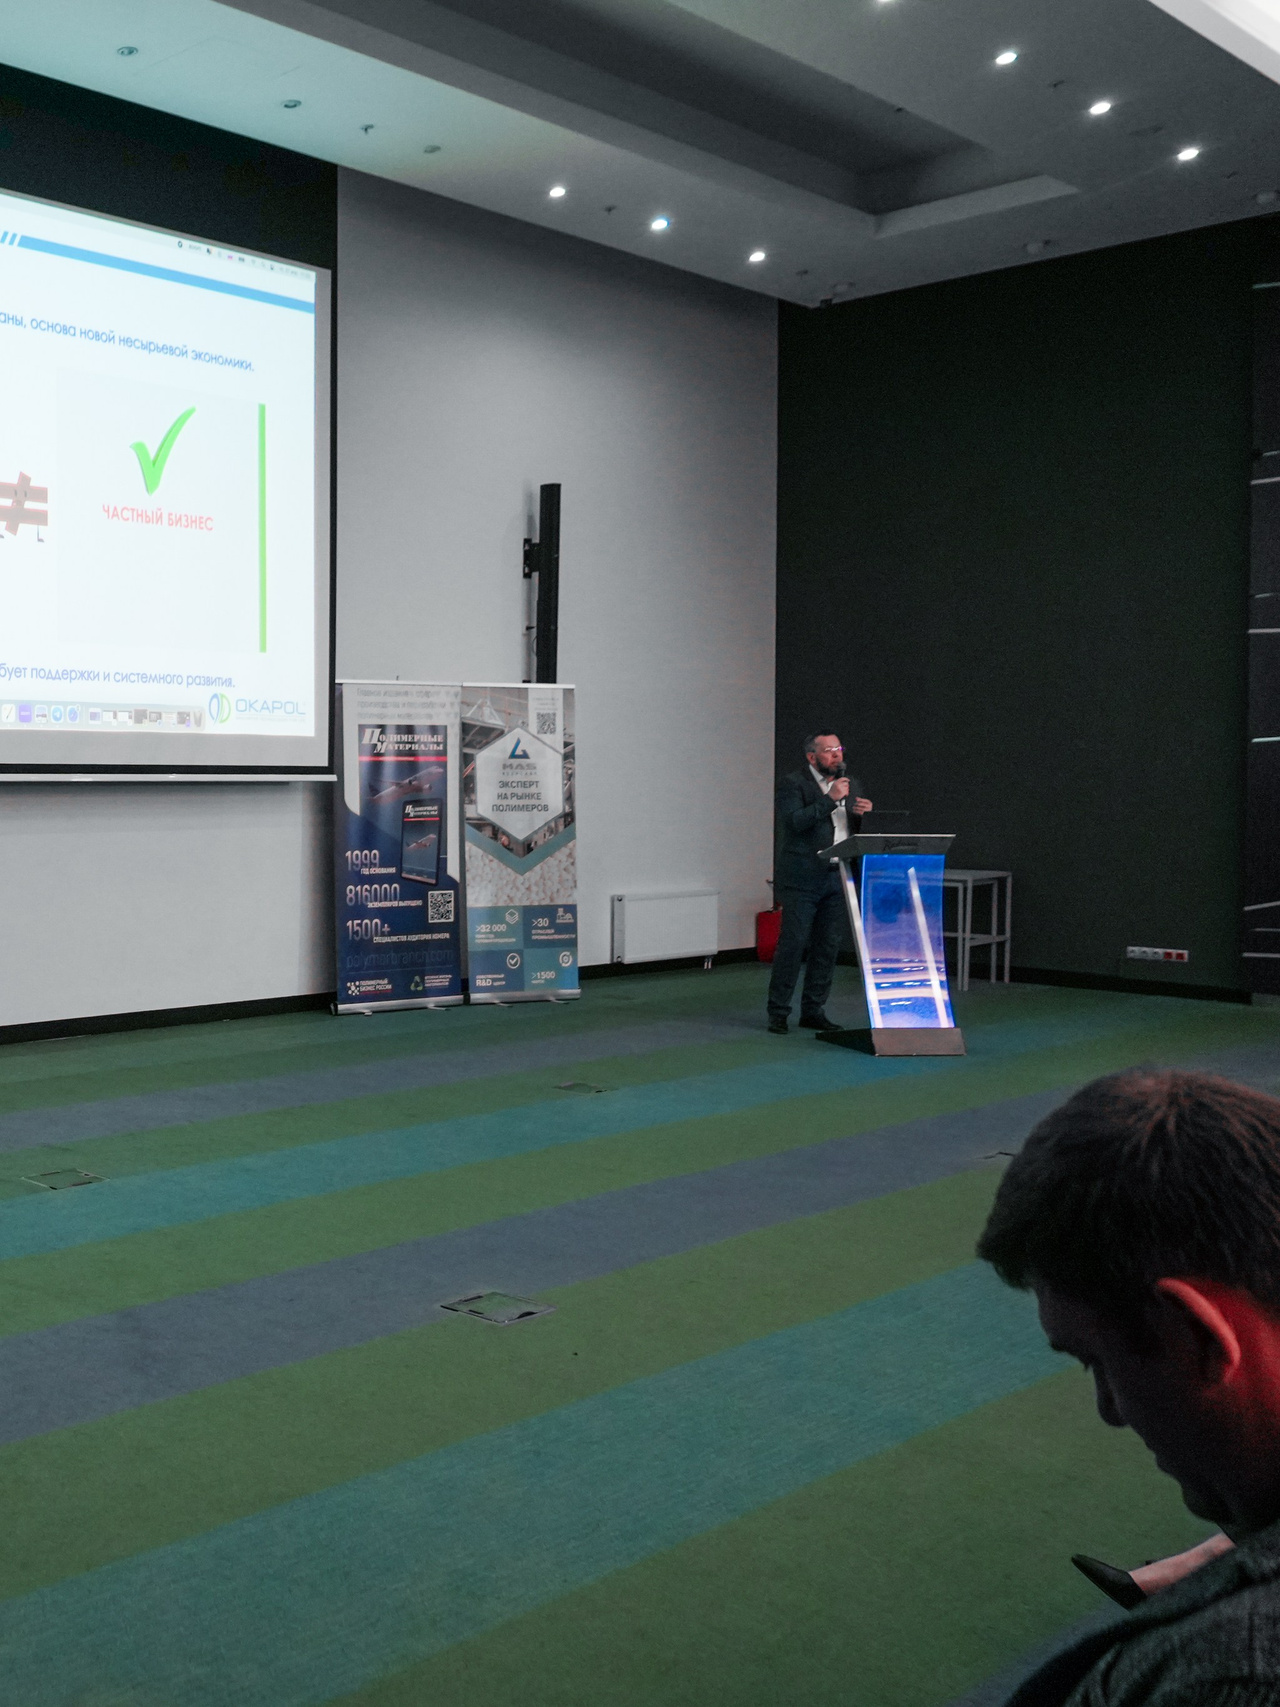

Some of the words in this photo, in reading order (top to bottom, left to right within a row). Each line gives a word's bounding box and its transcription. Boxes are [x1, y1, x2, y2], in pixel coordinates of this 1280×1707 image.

[30, 318, 76, 337] основа
[80, 328, 115, 344] новой
[119, 336, 188, 358] несырьевой
[191, 350, 254, 371] экономики.
[102, 504, 163, 526] ЧАСТНЫЙ
[168, 512, 214, 531] БИЗНЕС
[30, 667, 101, 683] поддержки
[103, 671, 111, 682] и
[113, 671, 183, 686] системного
[186, 675, 235, 688] развития.
[236, 699, 306, 715] OKAPOL
[502, 763, 536, 771] MAS
[499, 780, 539, 789] ЭКСПЕРТ
[497, 792, 508, 800] НА
[510, 792, 542, 800] РЫНКЕ
[492, 804, 549, 812] ПОЛИМЕРОВ
[345, 850, 379, 871] 1999
[346, 884, 400, 906] 816000
[346, 919, 390, 940] 1500+
[373, 935, 407, 943] СПЕЦИАЛИСТОВ
